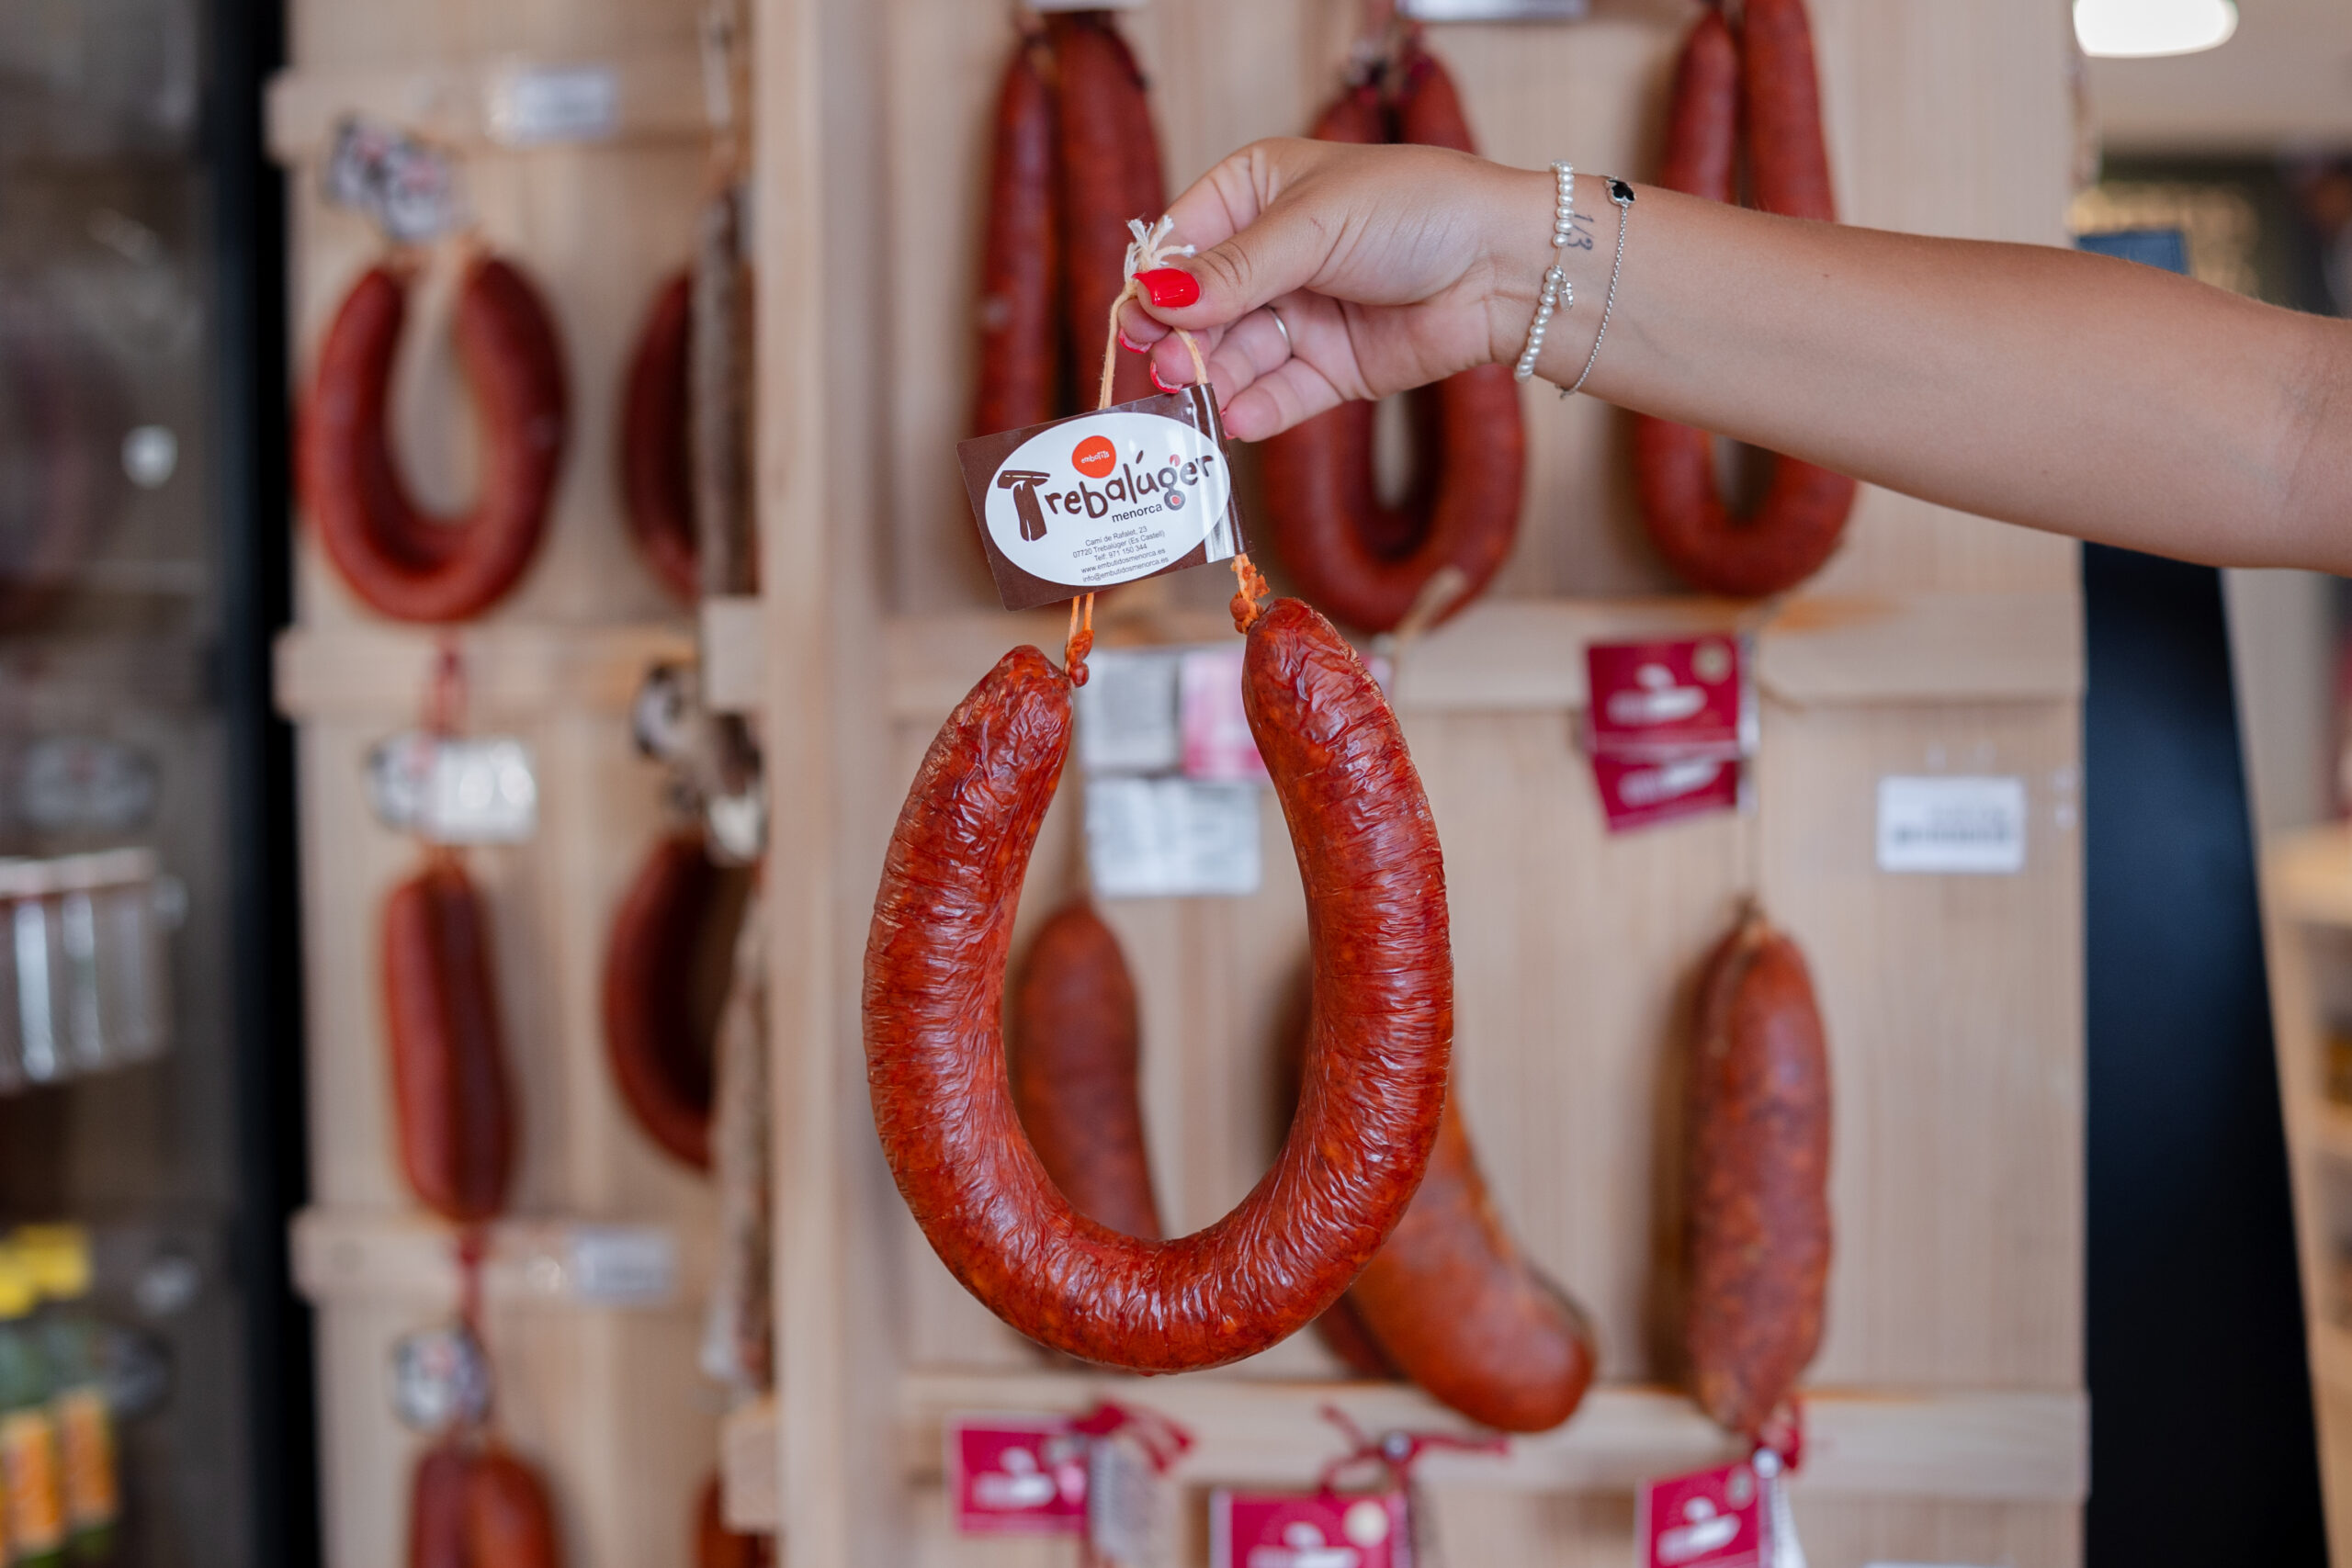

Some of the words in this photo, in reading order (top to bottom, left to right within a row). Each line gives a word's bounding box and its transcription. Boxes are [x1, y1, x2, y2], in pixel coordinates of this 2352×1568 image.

[997, 450, 1214, 542] Trebalúger
[1111, 502, 1163, 524] menorca
[1103, 535, 1113, 543] de
[1138, 525, 1148, 534] 23
[1072, 548, 1092, 558] 07720
[1128, 536, 1139, 547] (Es
[1108, 550, 1120, 558] 971
[1122, 546, 1134, 556] 150
[1136, 543, 1148, 552] 344
[1080, 548, 1166, 574] www.embutidosmenorca.es
[1082, 557, 1170, 582] info@embutidosmenorca.es
